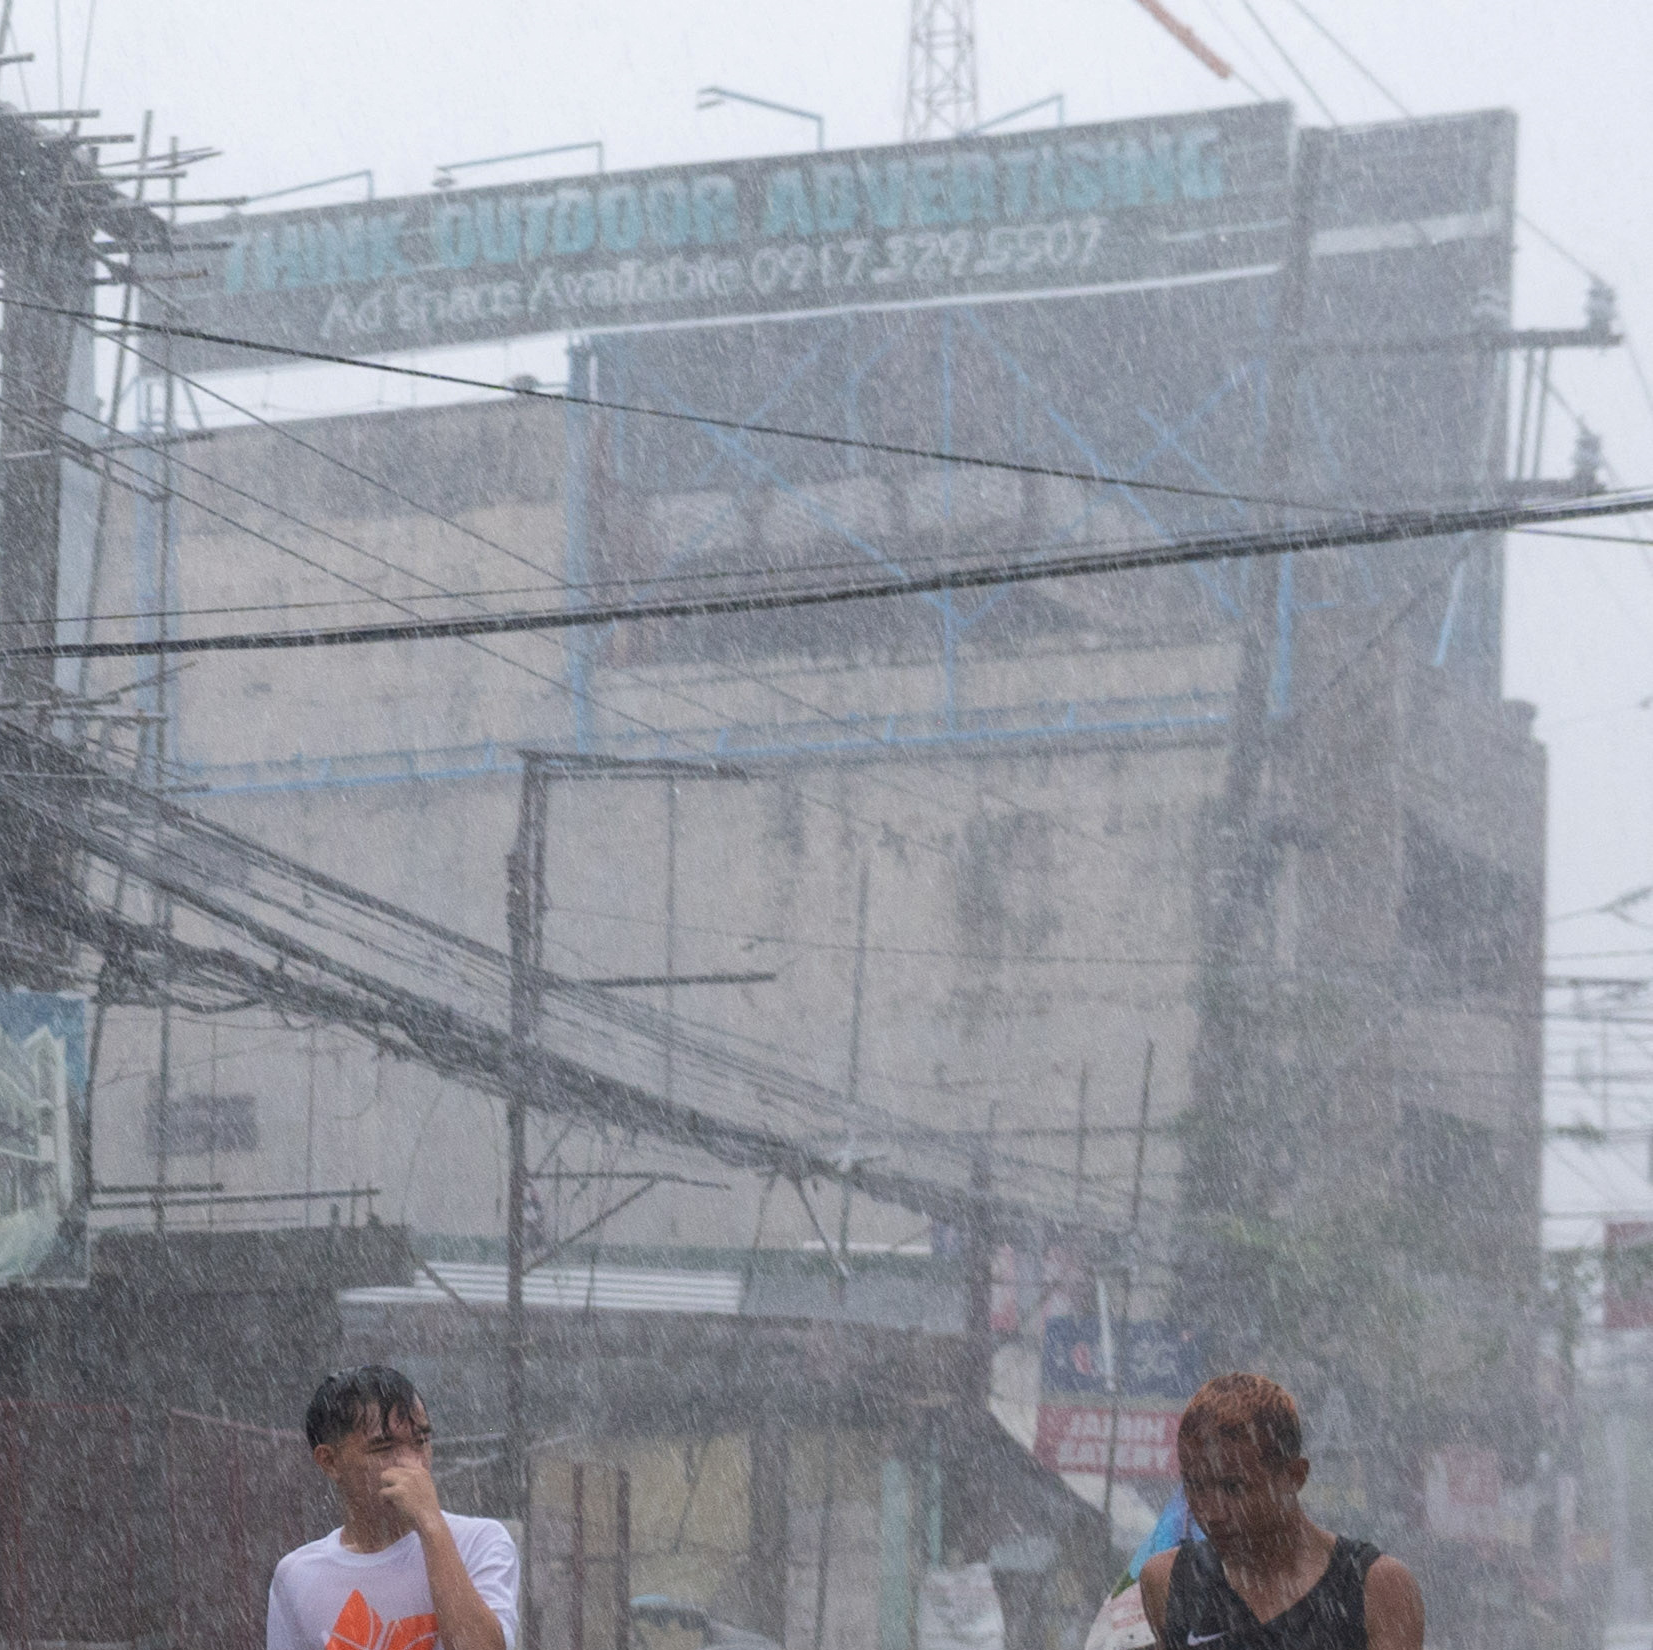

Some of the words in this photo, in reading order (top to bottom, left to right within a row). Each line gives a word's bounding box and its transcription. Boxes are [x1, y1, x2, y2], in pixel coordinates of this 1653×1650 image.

[435, 172, 740, 269] OUTDOOR
[761, 125, 1223, 237] ADVERTISING
[529, 252, 744, 314] Available
